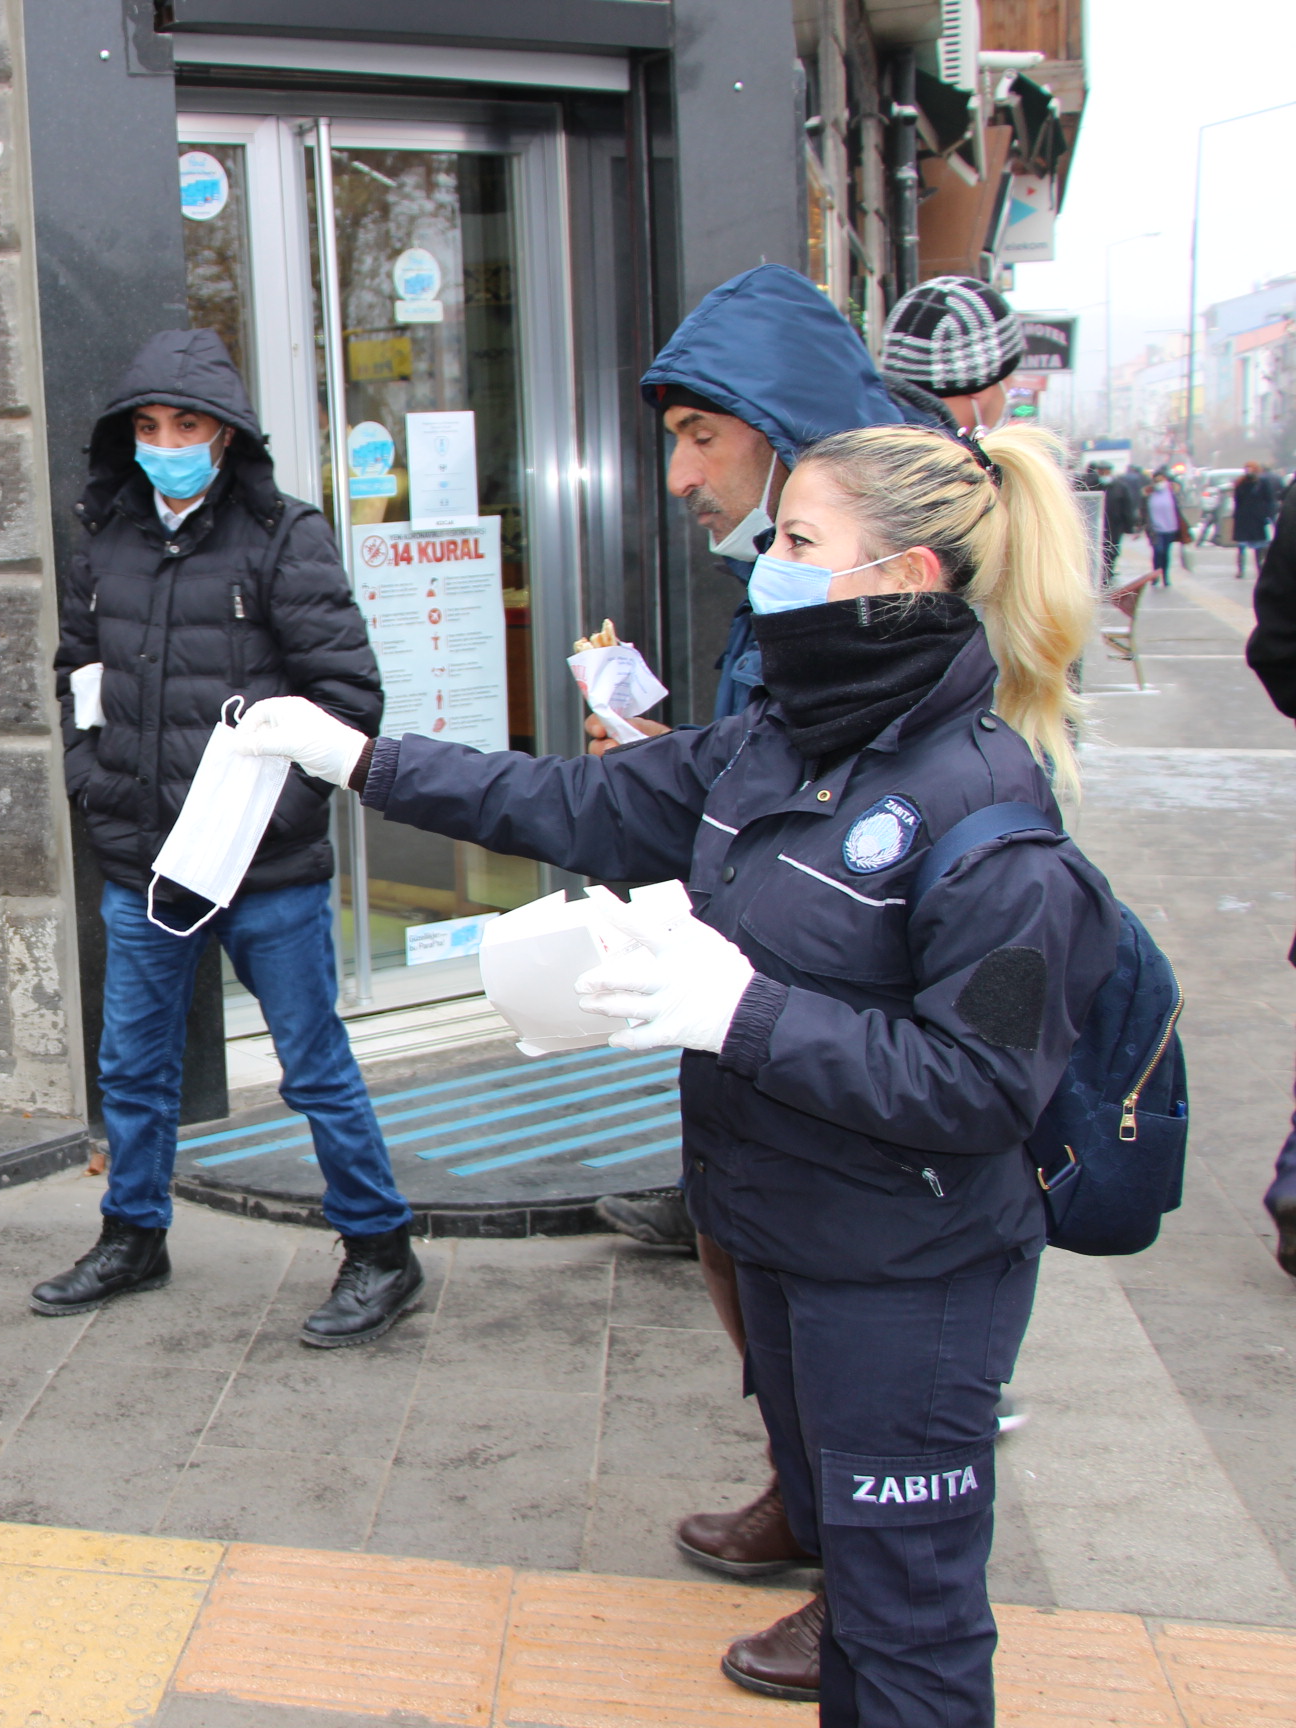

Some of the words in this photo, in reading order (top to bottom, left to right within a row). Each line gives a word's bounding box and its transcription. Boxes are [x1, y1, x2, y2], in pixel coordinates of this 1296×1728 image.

[1024, 323, 1068, 344] HOTEL
[417, 537, 485, 564] KURAL
[884, 799, 917, 826] ZABITA
[852, 1465, 979, 1504] ZABITA
